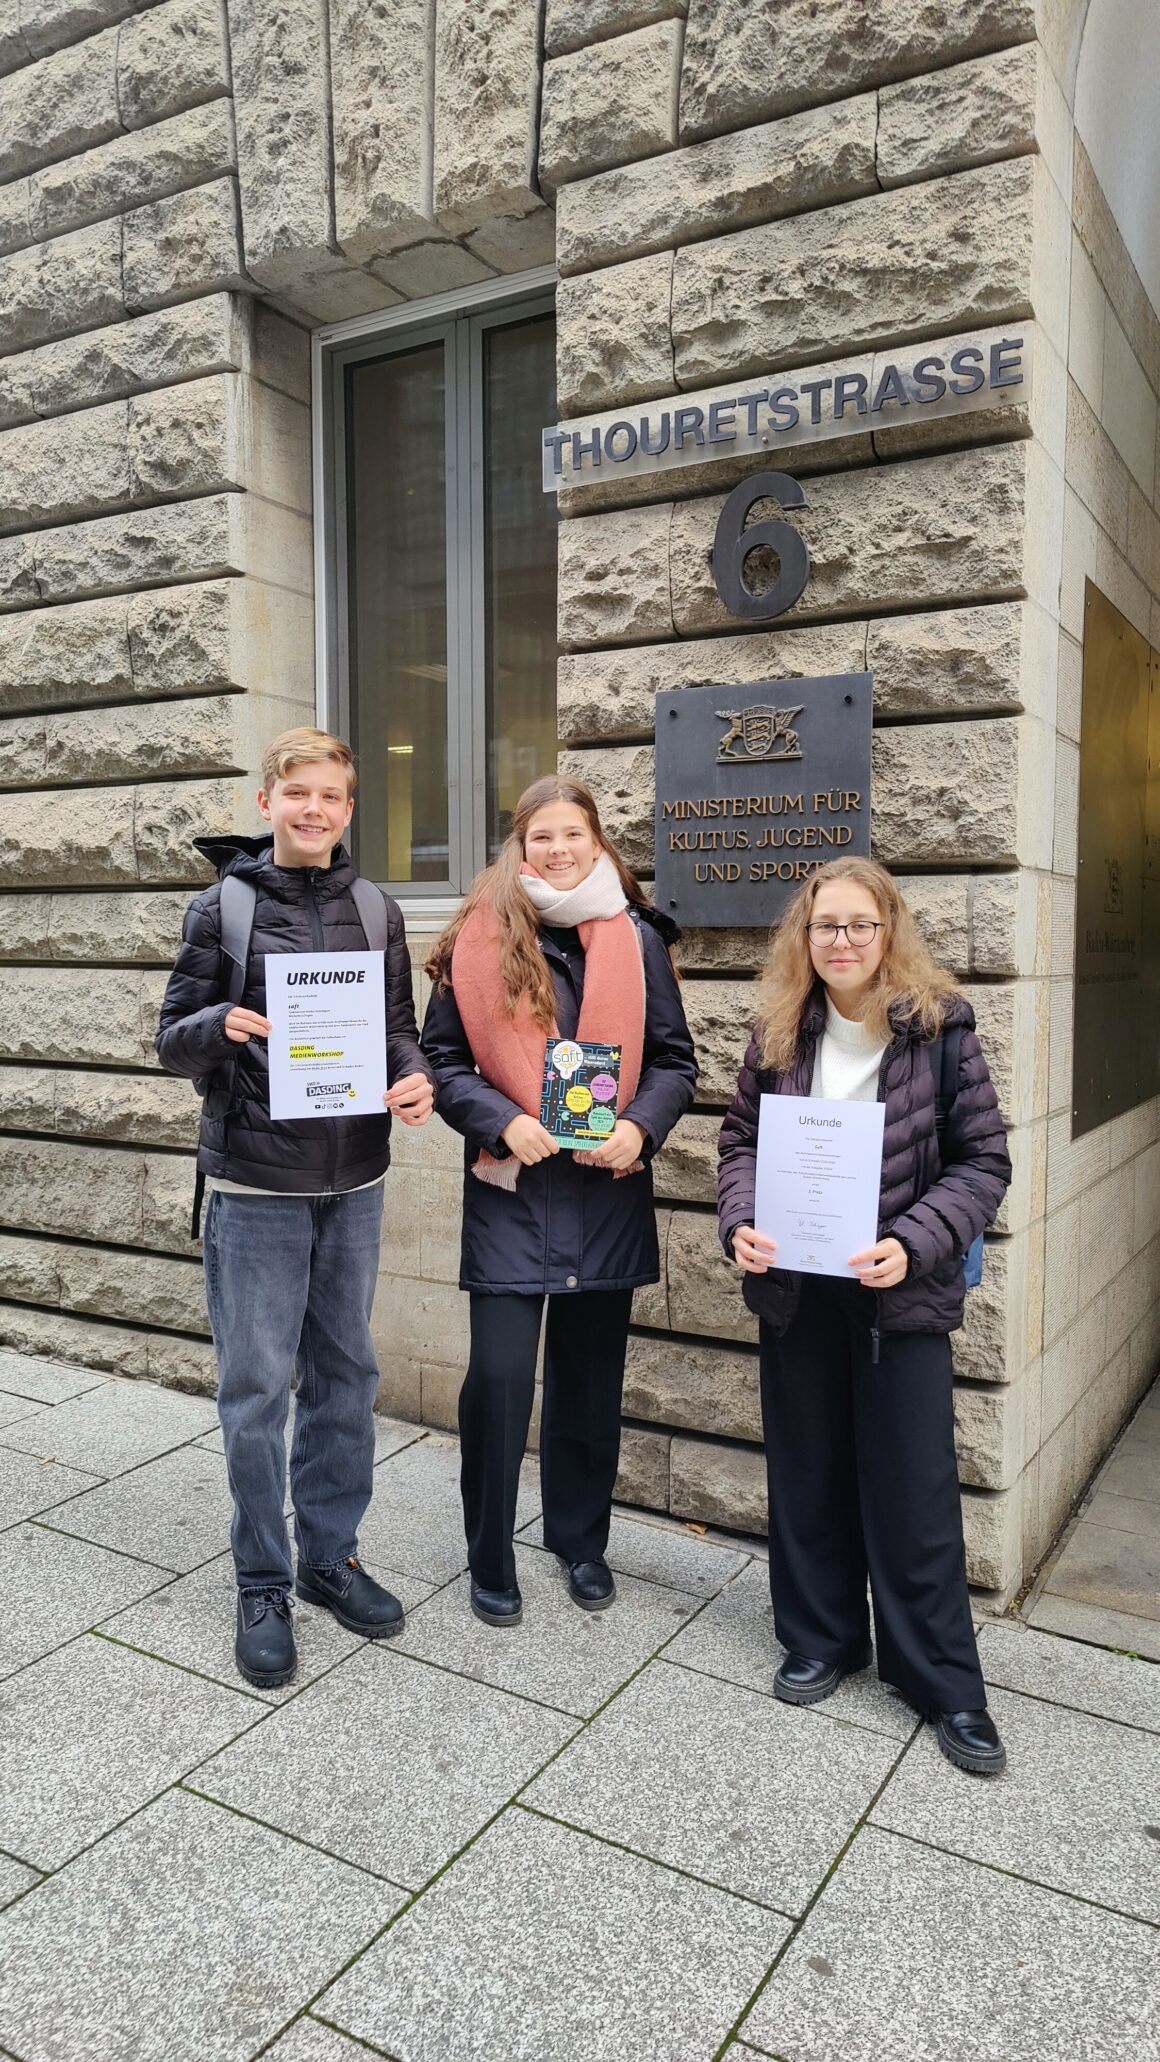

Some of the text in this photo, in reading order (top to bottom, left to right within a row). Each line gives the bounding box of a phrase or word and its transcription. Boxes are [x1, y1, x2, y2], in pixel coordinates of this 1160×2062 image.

[543, 338, 1025, 475] THOURETSTRASSE
[712, 471, 811, 621] 6
[661, 788, 863, 820] MINISTERIUM FÜR
[668, 826, 854, 851] KULTUS, JUGEND
[694, 862, 742, 882] UND
[286, 970, 366, 986] URKUNDE
[289, 1051, 344, 1059] MEDIENWORKSHOP
[308, 1084, 350, 1096] DASDING
[798, 1115, 842, 1128] Urkunde
